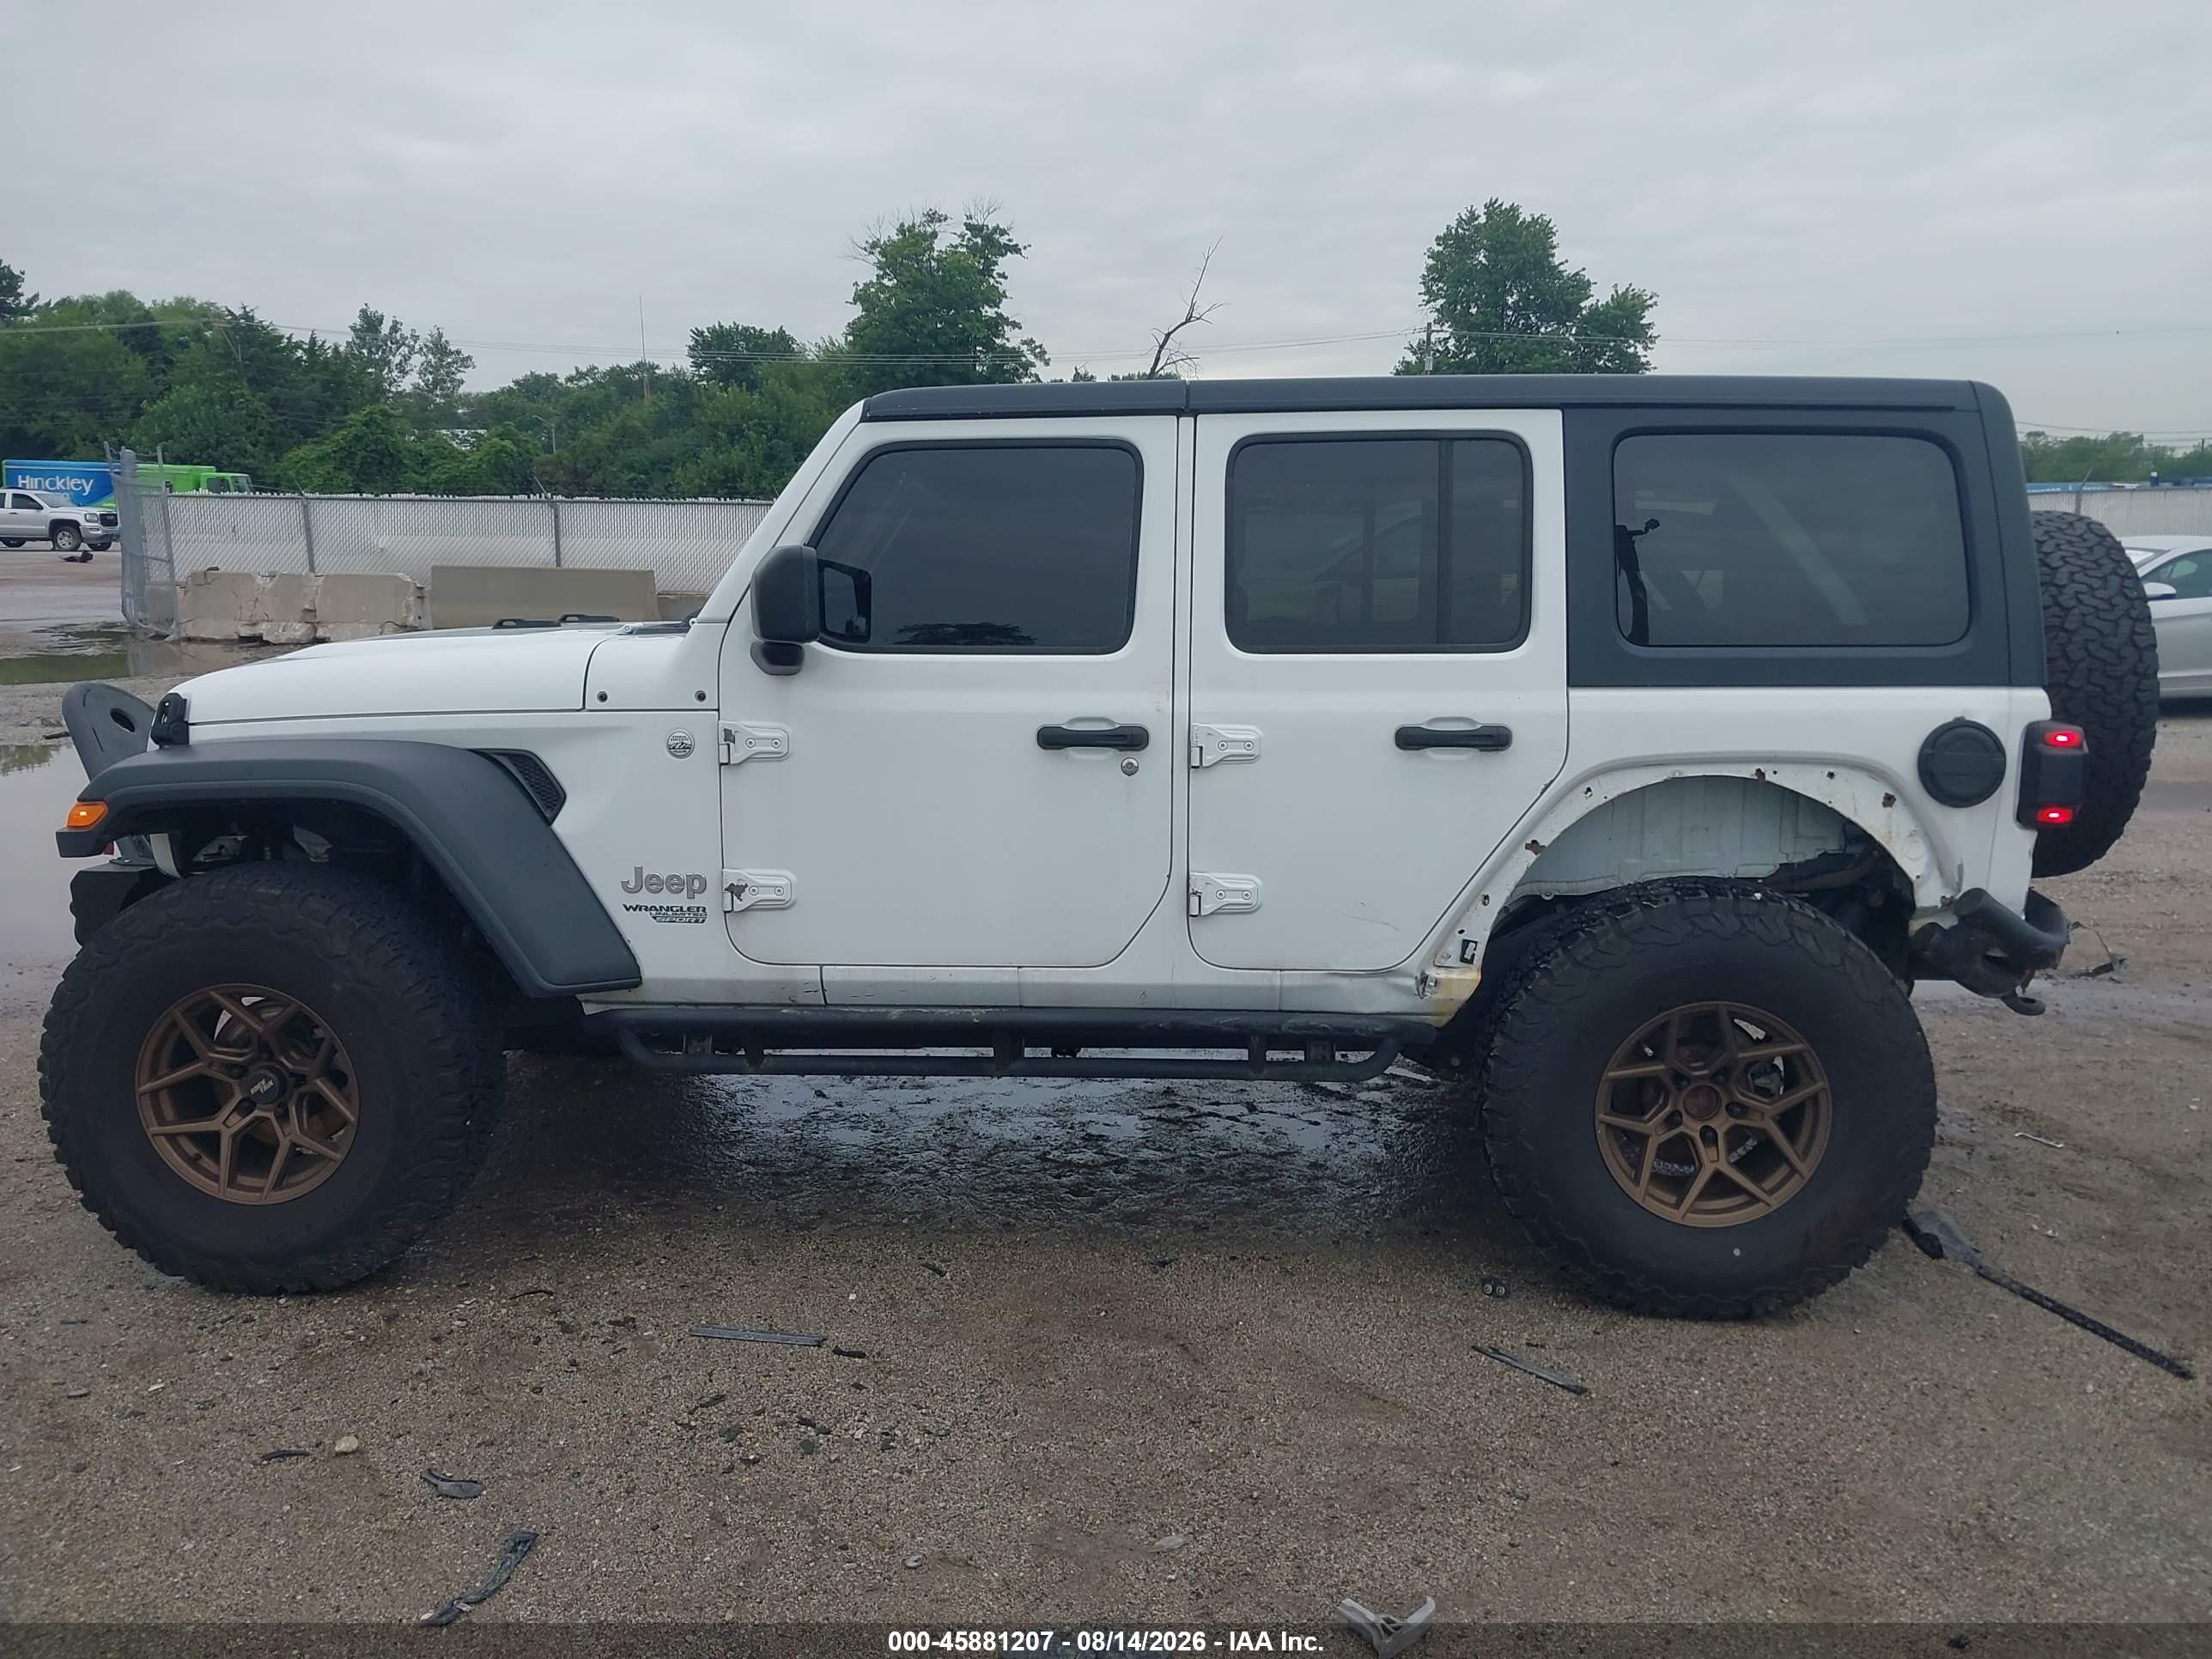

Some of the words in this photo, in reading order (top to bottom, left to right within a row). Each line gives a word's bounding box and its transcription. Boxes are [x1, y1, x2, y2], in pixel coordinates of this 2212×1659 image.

[17, 475, 94, 495] Hinckley
[621, 866, 707, 899] Jeep
[622, 904, 707, 913] WRANGLER
